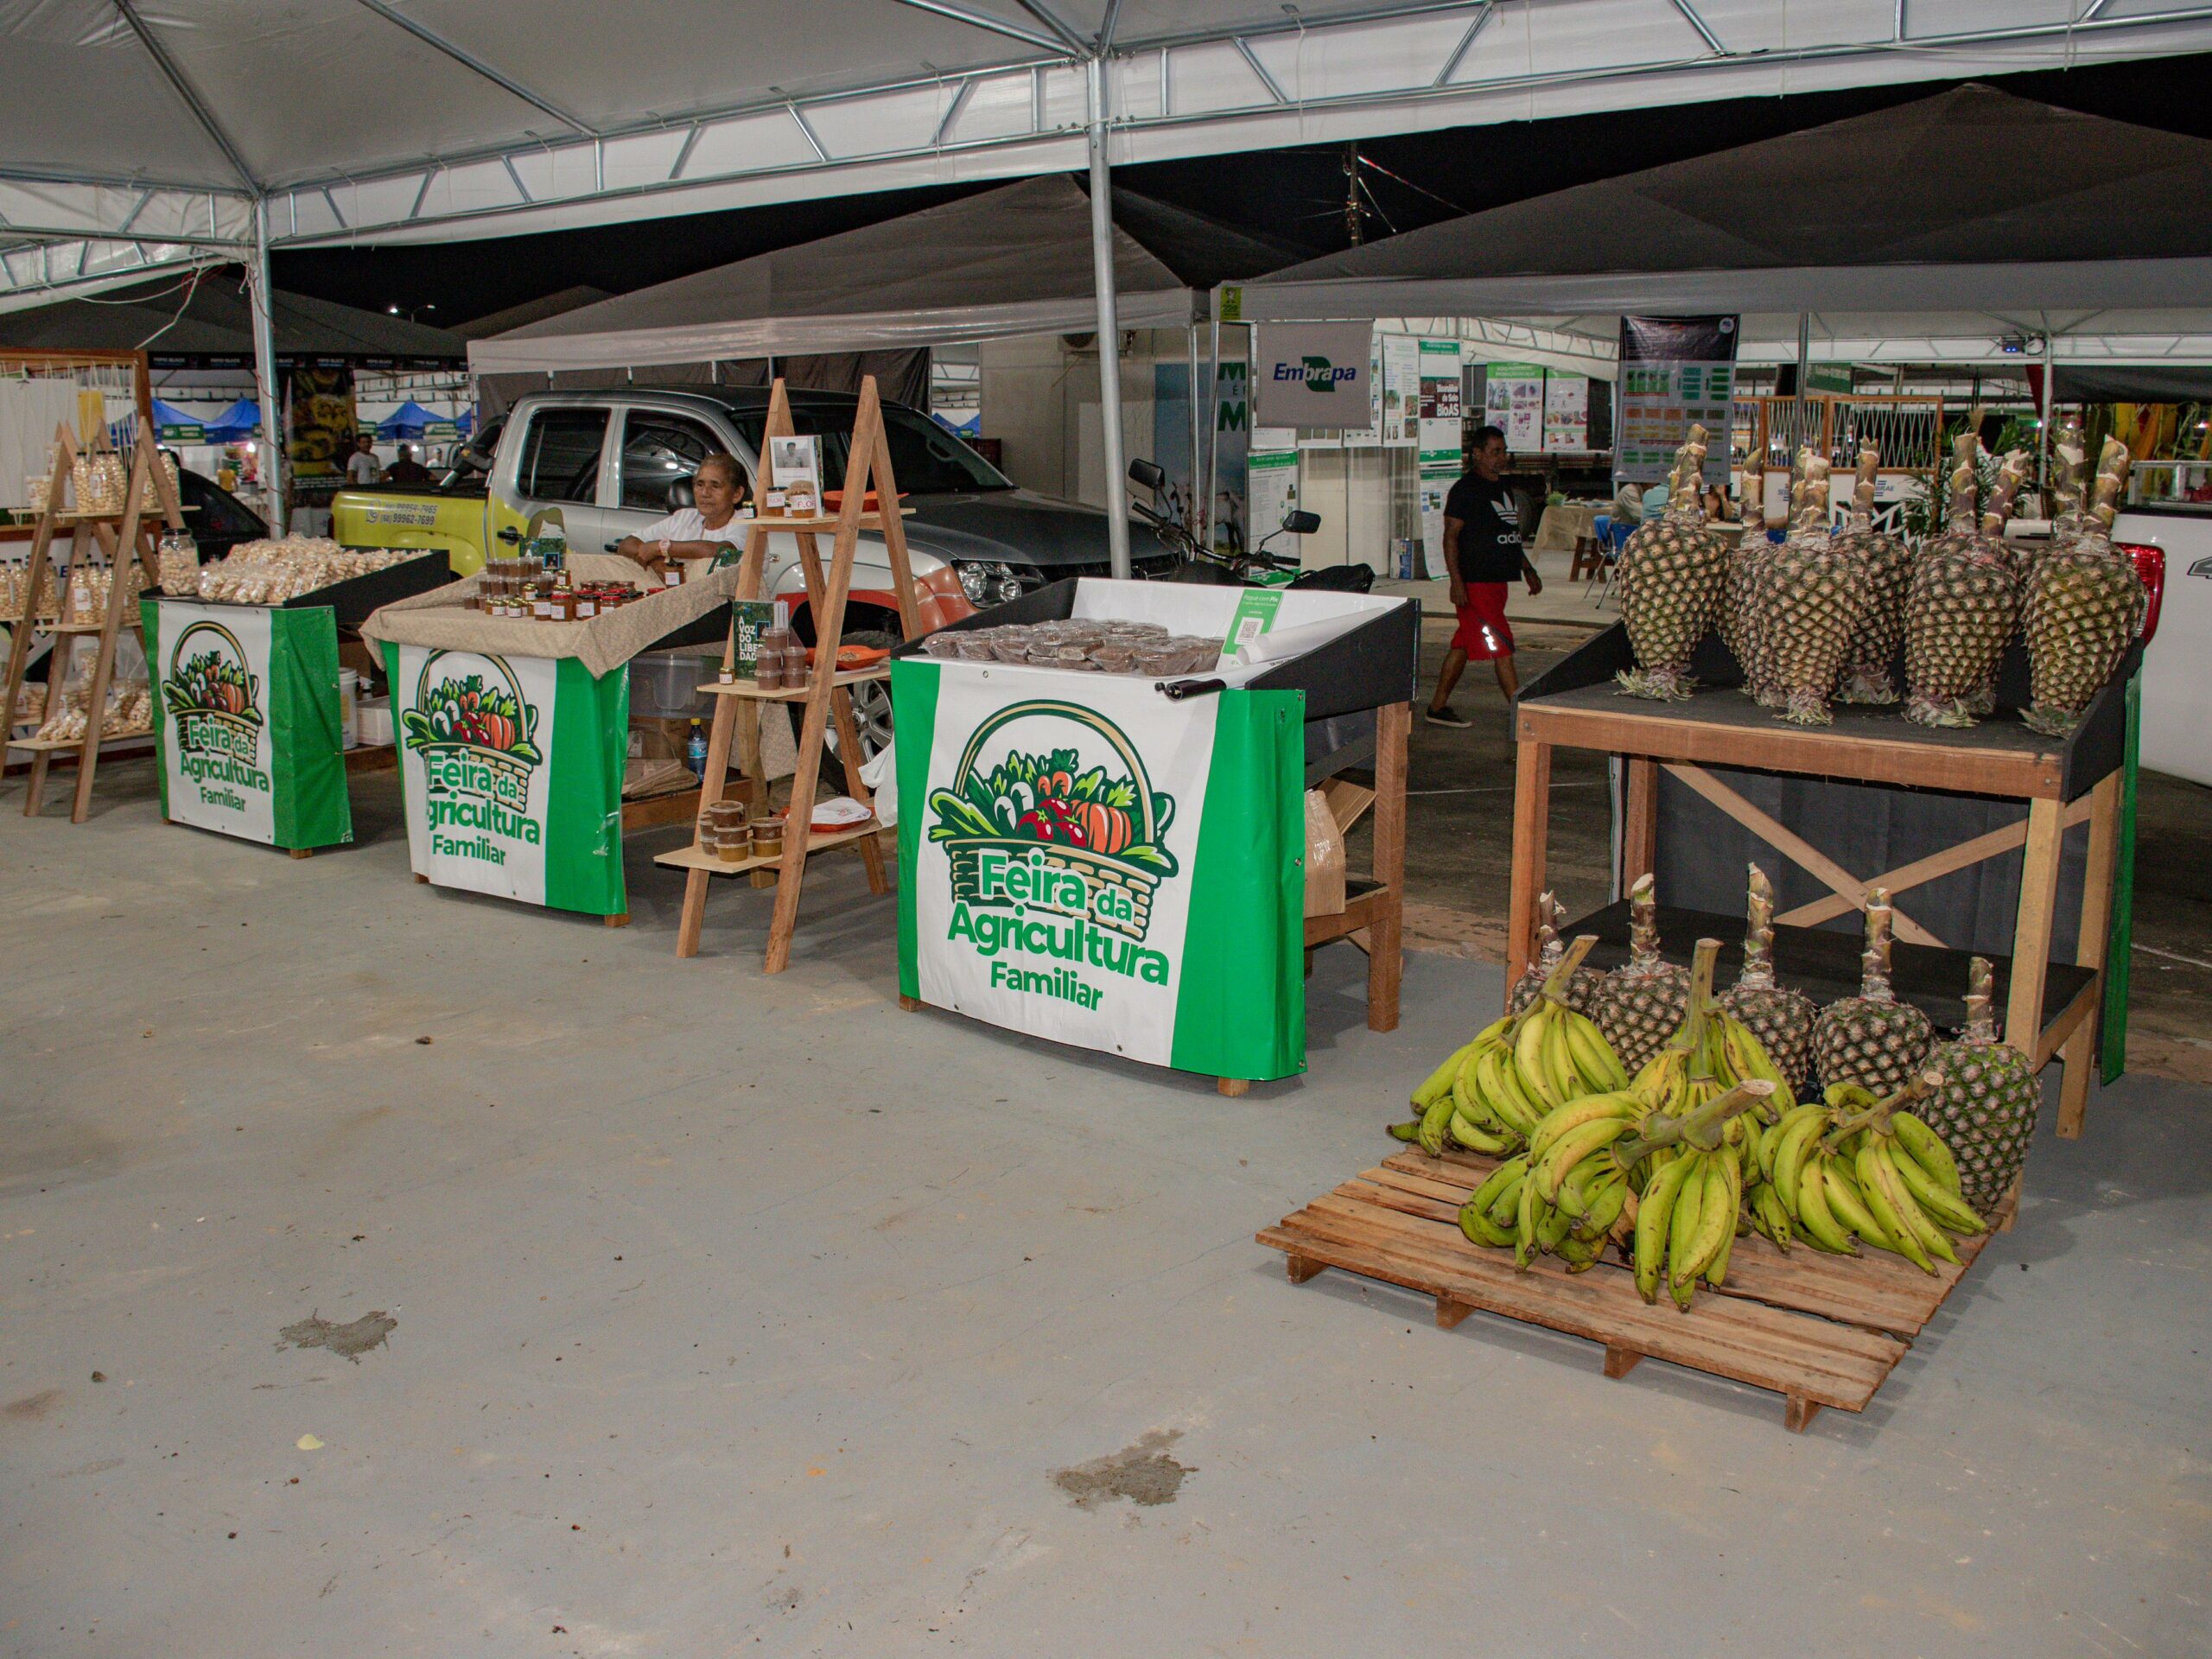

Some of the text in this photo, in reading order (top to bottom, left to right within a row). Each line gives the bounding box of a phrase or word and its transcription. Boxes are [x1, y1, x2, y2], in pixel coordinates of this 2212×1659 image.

[1273, 362, 1357, 388] Embrapa
[1436, 403, 1459, 417] BioAS
[392, 513, 435, 525] 99962-7699
[738, 615, 745, 625] A
[739, 626, 756, 634] VOZ
[739, 634, 751, 643] DO
[189, 717, 249, 755] Feira da
[181, 749, 270, 793] Agricultura
[429, 753, 517, 799] Feira da
[200, 786, 246, 812] Familiar
[429, 791, 541, 846] gricultura
[432, 834, 506, 866] Familiar
[981, 854, 1132, 923] Feira da
[947, 904, 1170, 987] Agricultura
[990, 960, 1103, 1012] Familiar
